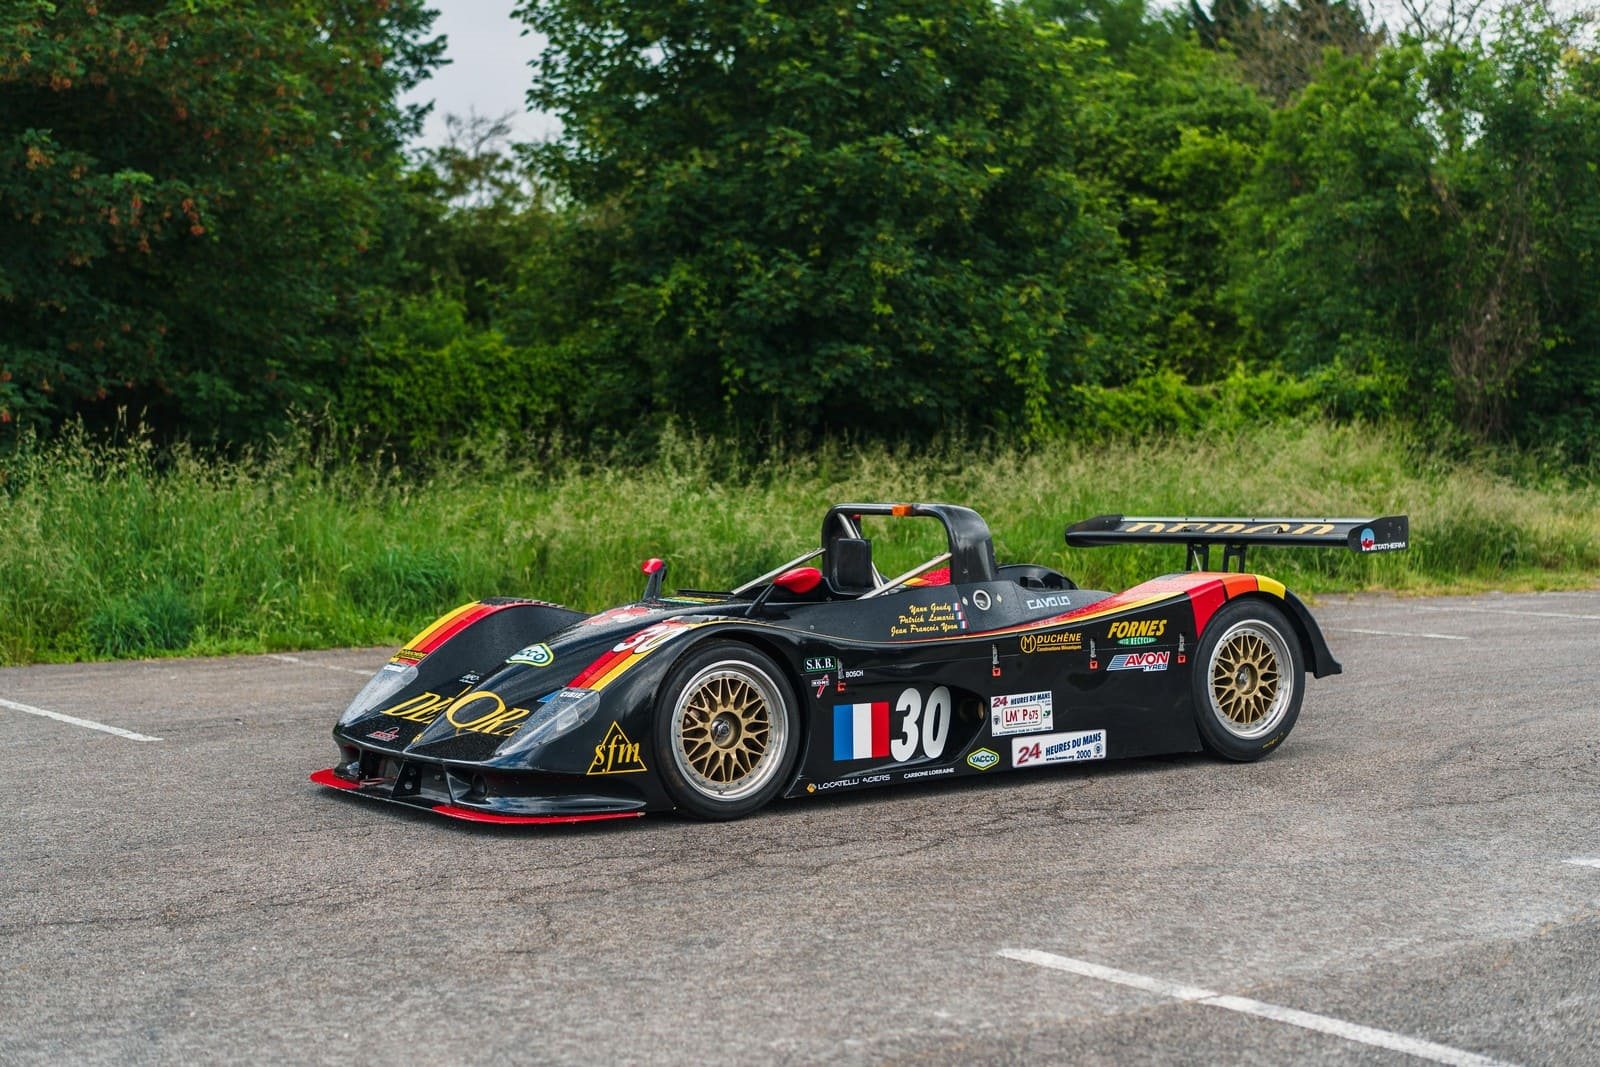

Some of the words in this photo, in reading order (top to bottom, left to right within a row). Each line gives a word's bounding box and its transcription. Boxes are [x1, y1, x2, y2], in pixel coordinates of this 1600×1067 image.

[890, 626, 907, 637] Jean
[1107, 619, 1168, 639] FORNES
[1037, 632, 1082, 644] DUCHÊNE
[806, 657, 834, 670] S.K.B.
[1125, 652, 1170, 667] AVON
[845, 670, 864, 678] BOSCH
[1143, 664, 1167, 672] TYRES
[992, 696, 1008, 708] 24
[1010, 697, 1029, 706] HEURES
[1037, 692, 1051, 700] MANS
[891, 687, 951, 762] 30
[1016, 742, 1042, 765] 24
[1045, 740, 1071, 757] HEURES
[1071, 738, 1082, 749] DU
[1082, 732, 1102, 746] MANS
[1076, 749, 1092, 759] 2000
[971, 754, 996, 764] YACCO
[903, 769, 929, 779] CARBONE
[928, 767, 955, 776] LORRAINE
[817, 777, 860, 790] LOCATELLI
